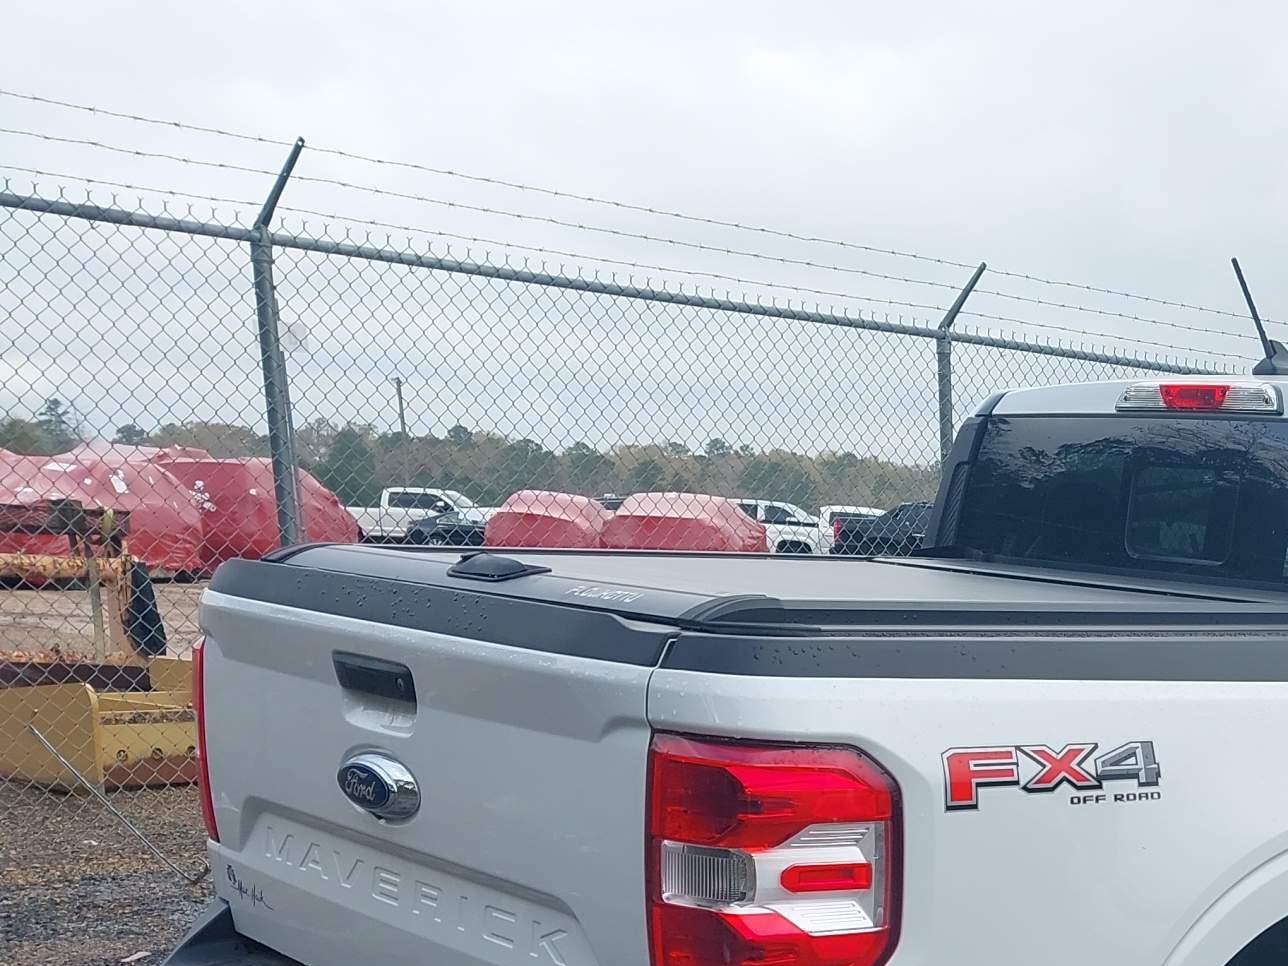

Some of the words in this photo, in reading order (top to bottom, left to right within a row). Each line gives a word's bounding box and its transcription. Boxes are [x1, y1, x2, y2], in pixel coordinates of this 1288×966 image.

[344, 767, 377, 801] Ford
[941, 740, 1162, 813] FX4
[1069, 794, 1107, 806] OFF
[1113, 790, 1162, 803] ROAD
